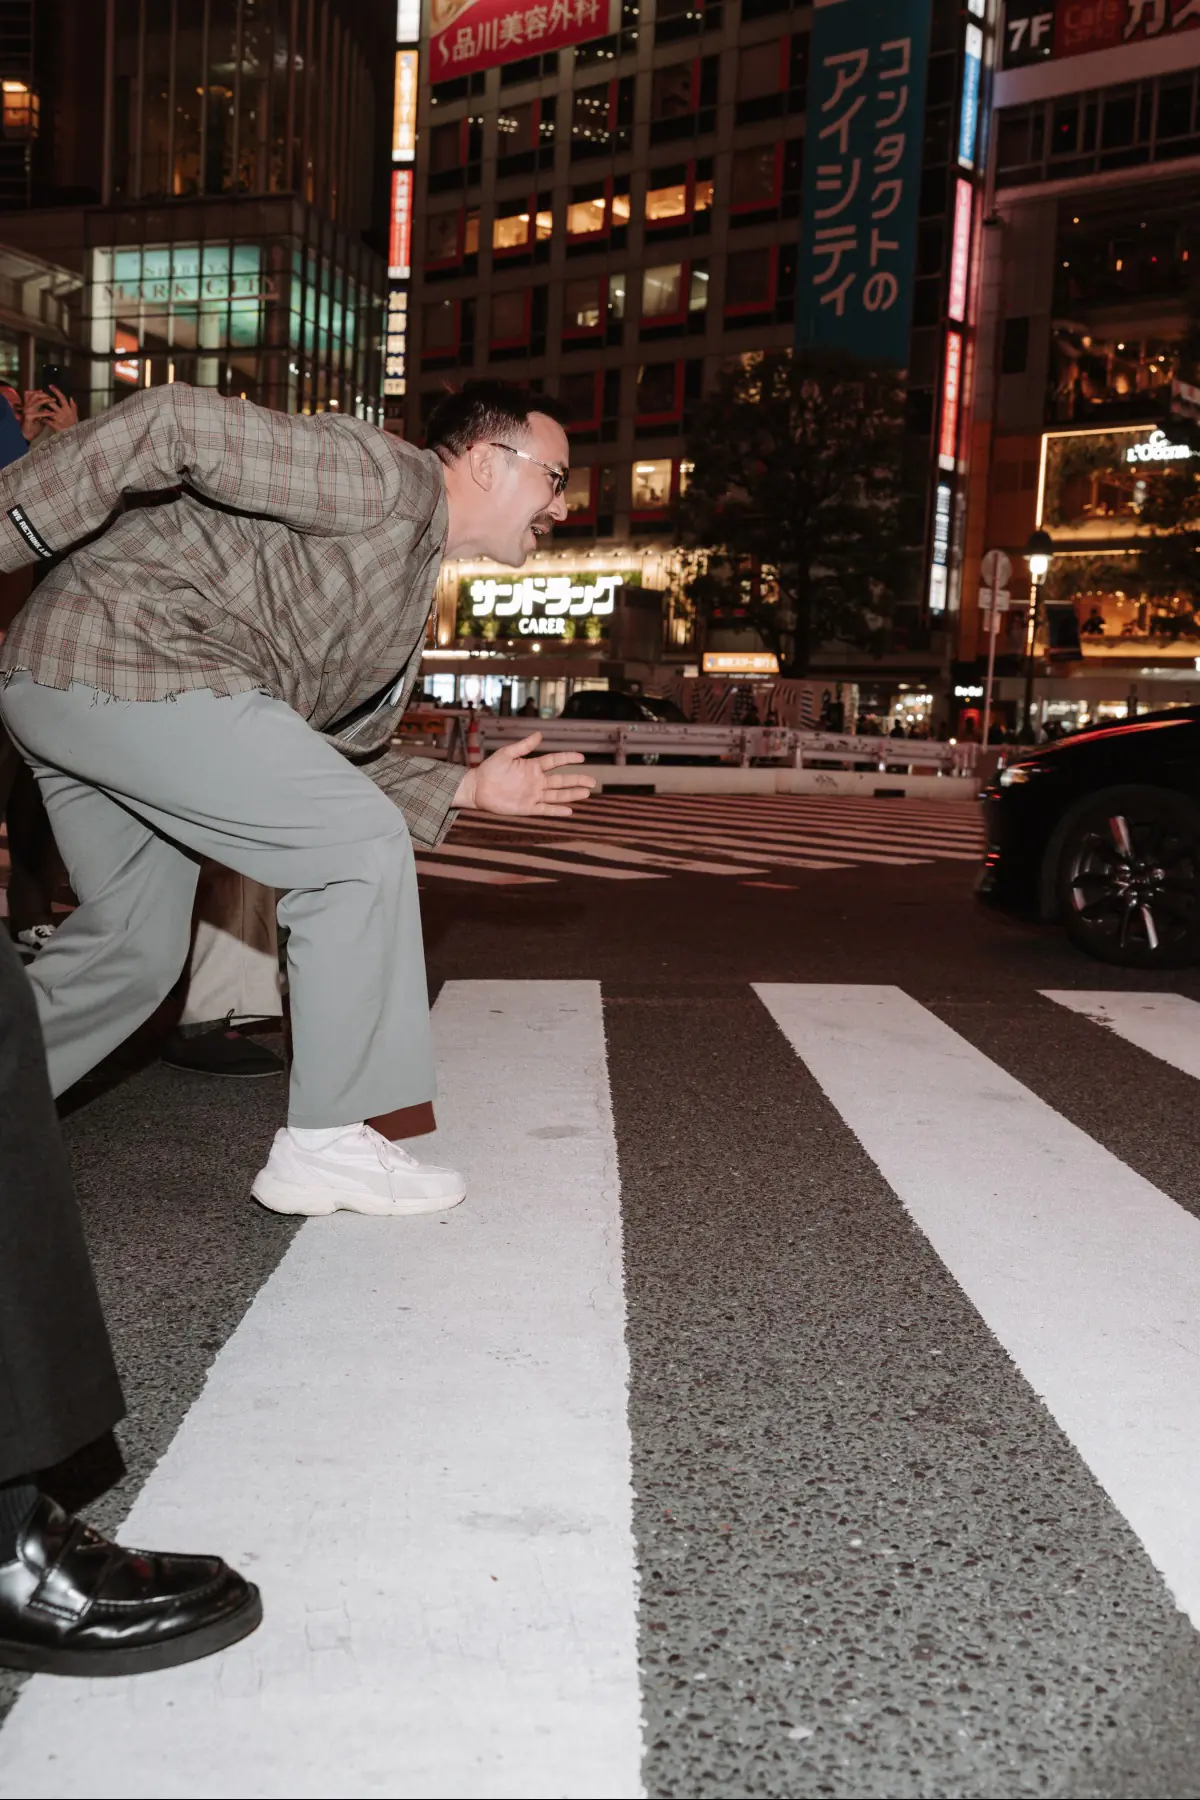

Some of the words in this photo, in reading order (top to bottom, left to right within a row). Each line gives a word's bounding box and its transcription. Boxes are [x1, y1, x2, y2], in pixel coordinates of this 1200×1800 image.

[452, 0, 600, 60] 品川美容外科
[1008, 13, 1053, 52] 7F
[812, 48, 869, 316] アイシティ
[863, 37, 911, 312] コンタクトの
[103, 281, 188, 301] MARK
[205, 275, 278, 297] CITY
[12, 508, 23, 522] WE
[19, 521, 43, 549] RETHINK
[470, 576, 623, 616] サンドラッグ
[518, 618, 566, 634] CARER
